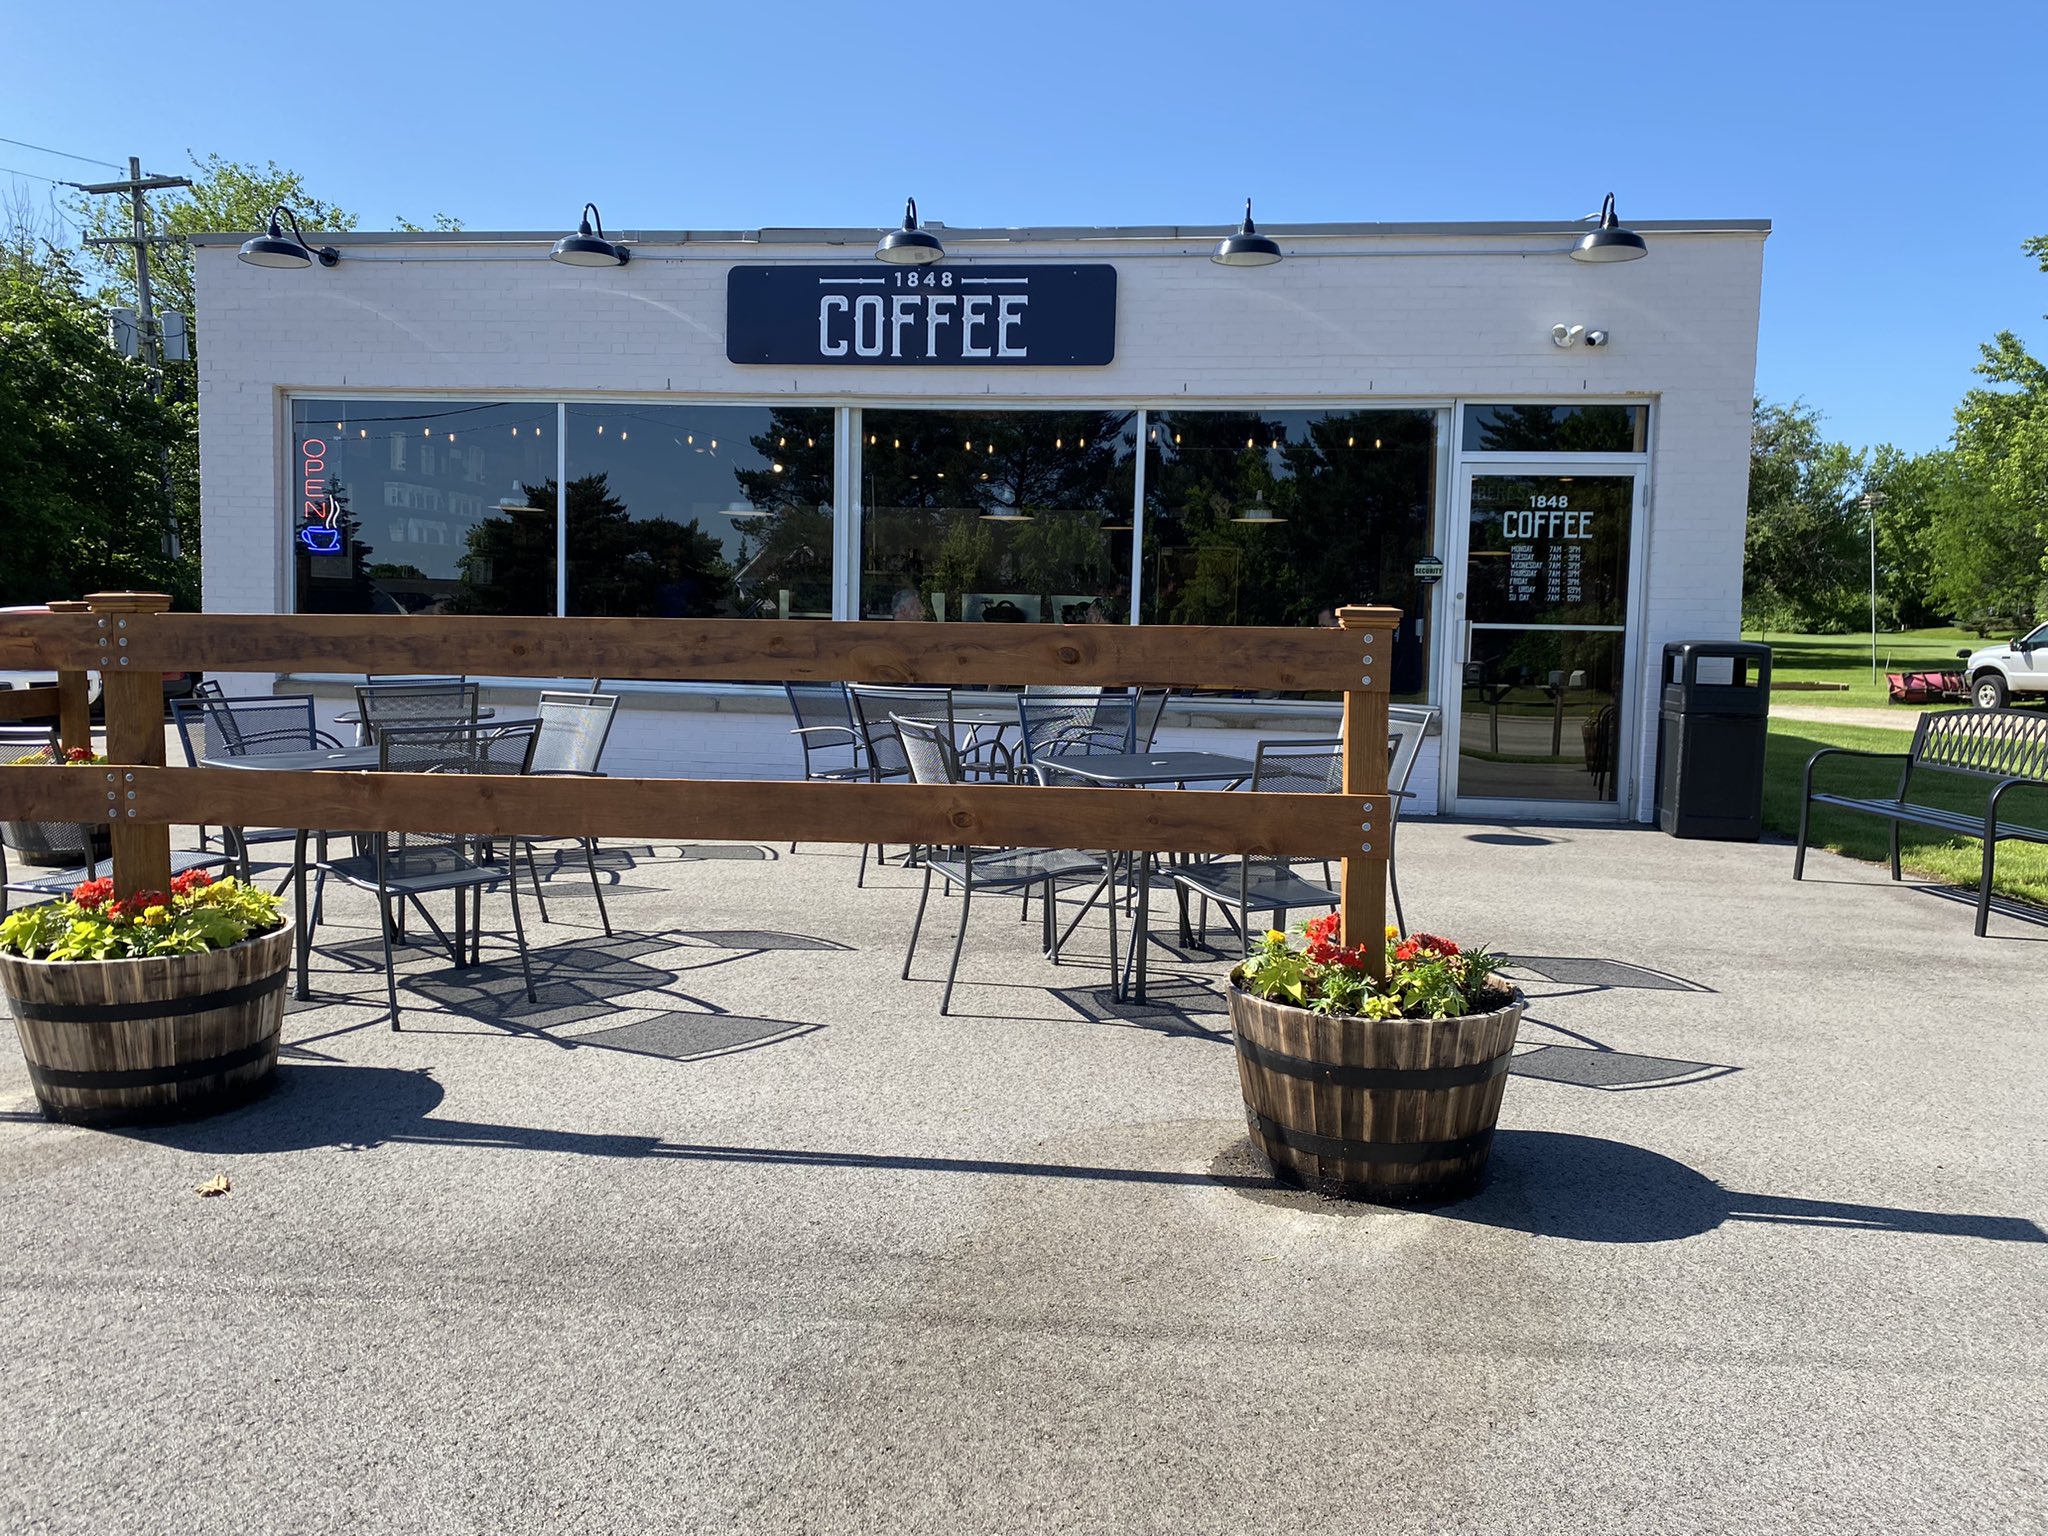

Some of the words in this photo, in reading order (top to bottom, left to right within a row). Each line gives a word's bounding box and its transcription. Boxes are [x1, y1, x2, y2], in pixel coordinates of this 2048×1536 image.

[894, 272, 953, 287] 1848
[818, 294, 1028, 357] COFFEE
[302, 439, 326, 518] OPEN
[1529, 495, 1568, 508] 1848
[1503, 511, 1594, 539] COFFEE
